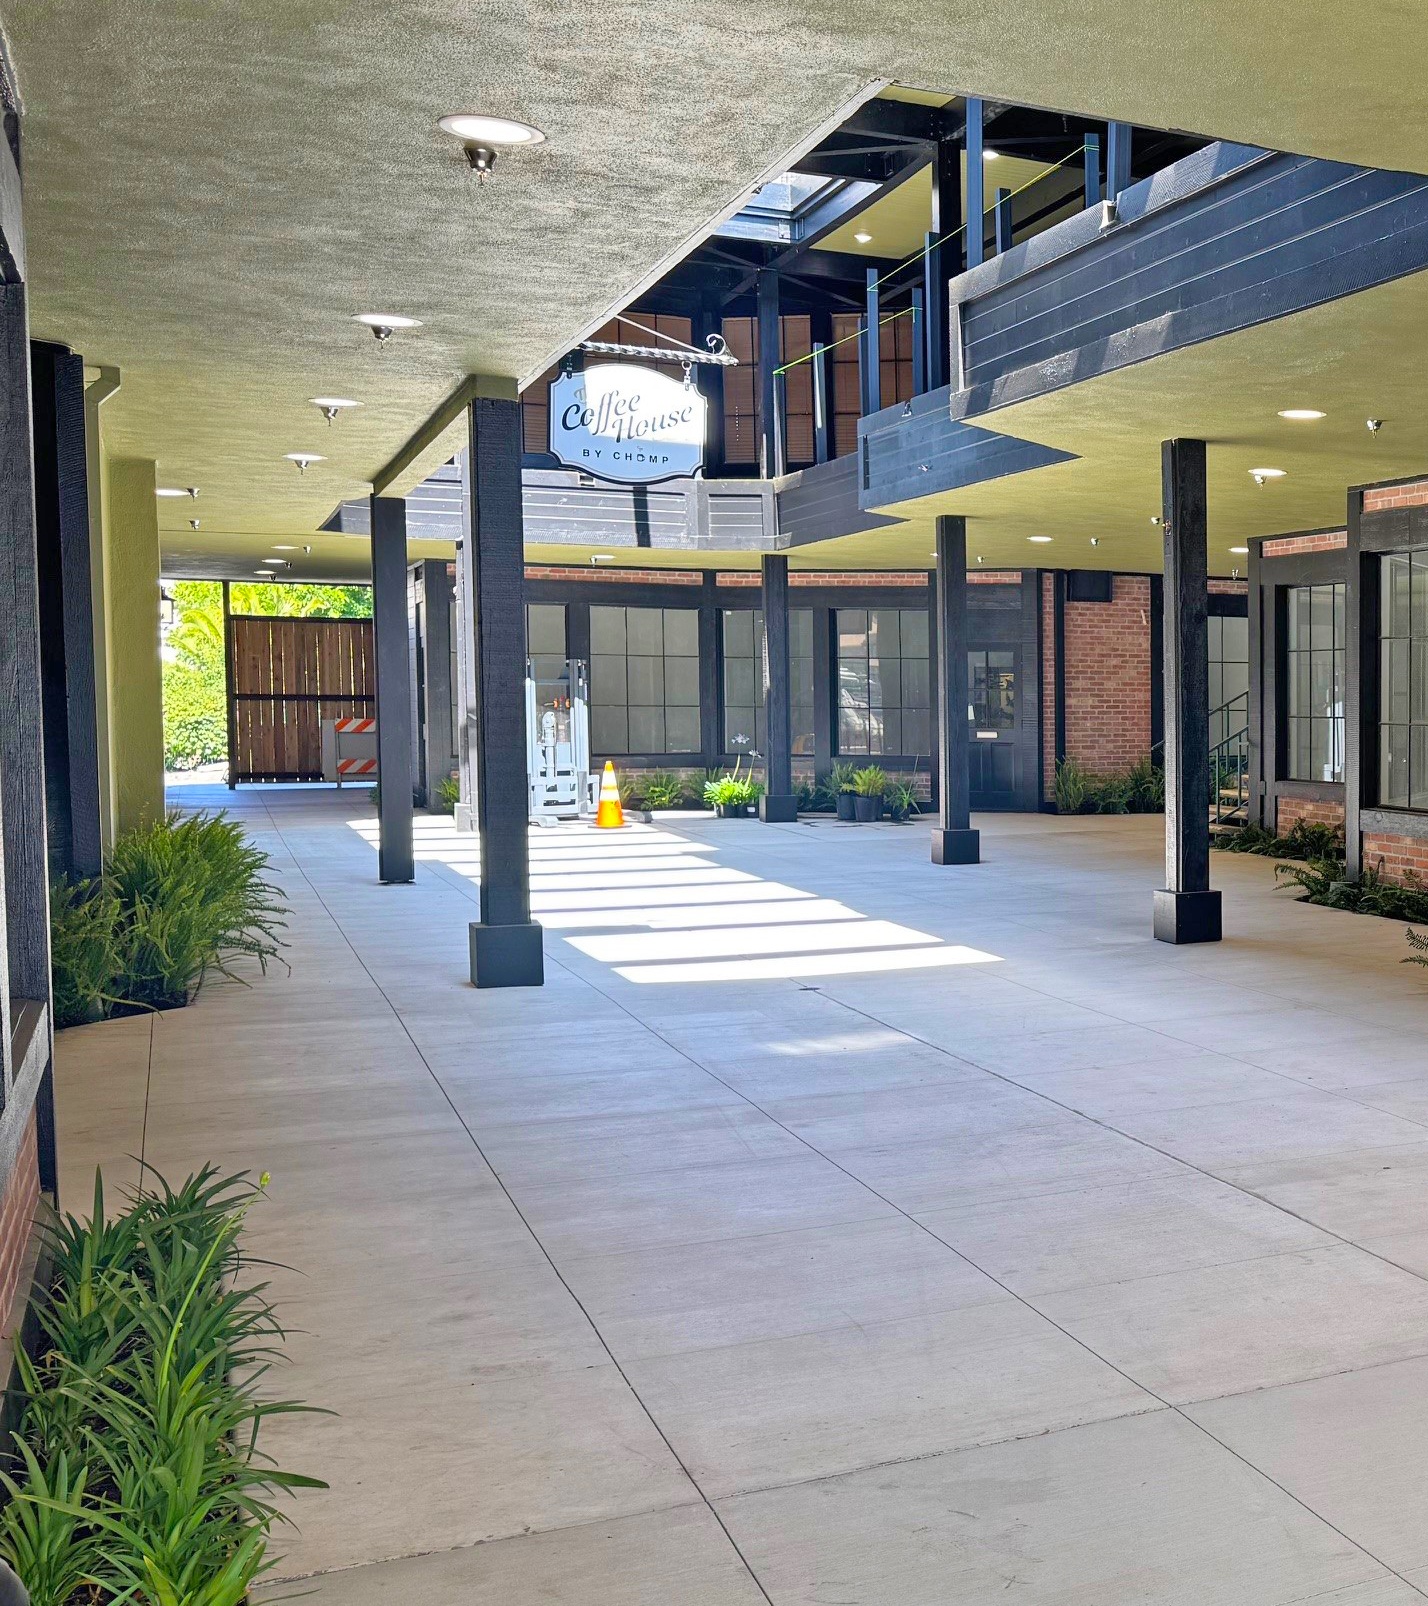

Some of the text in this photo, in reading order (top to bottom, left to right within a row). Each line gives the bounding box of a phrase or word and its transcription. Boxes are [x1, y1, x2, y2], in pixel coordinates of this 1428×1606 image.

[562, 389, 641, 436] Coffee
[612, 406, 692, 443] House
[583, 449, 669, 464] BY CHOMP
